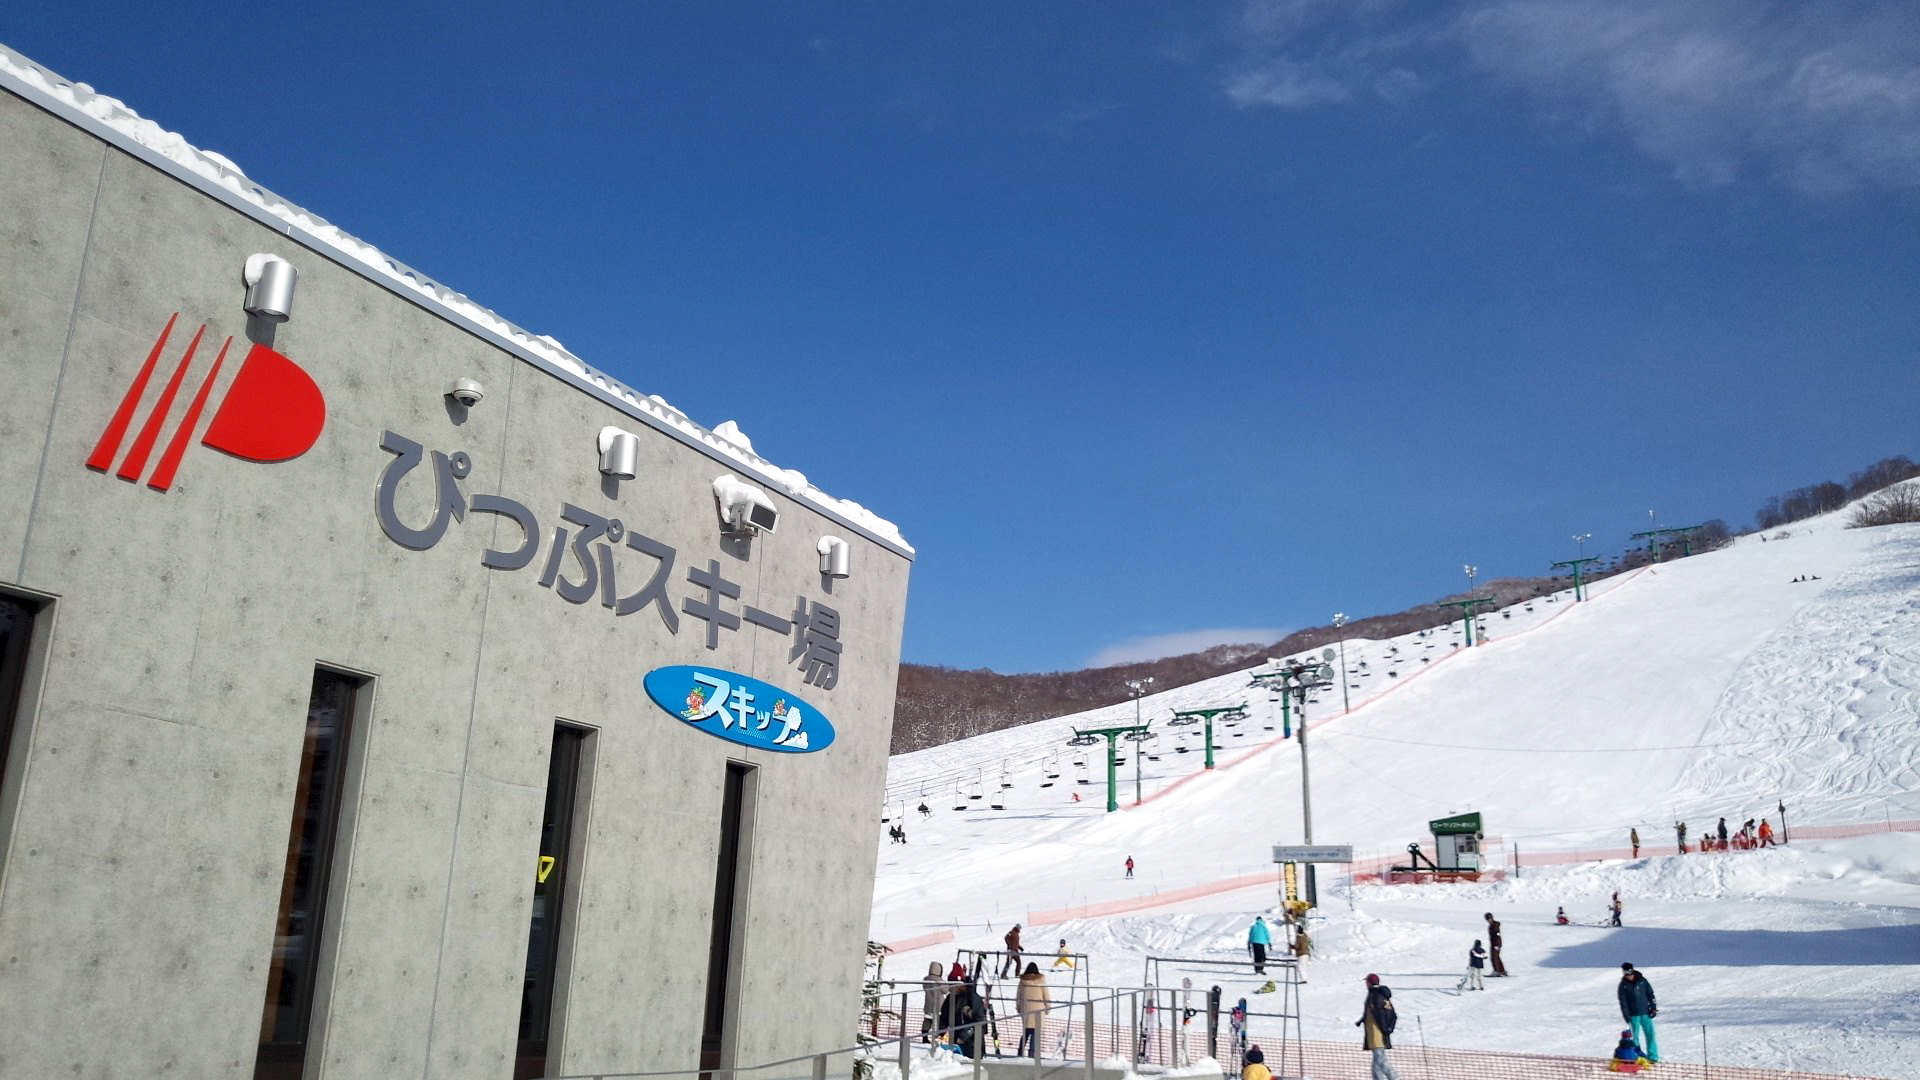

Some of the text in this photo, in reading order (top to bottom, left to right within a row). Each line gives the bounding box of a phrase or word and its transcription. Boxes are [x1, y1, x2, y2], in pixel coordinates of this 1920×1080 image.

[375, 430, 842, 690] ぴっぷスキー場
[688, 672, 803, 744] スキップ
